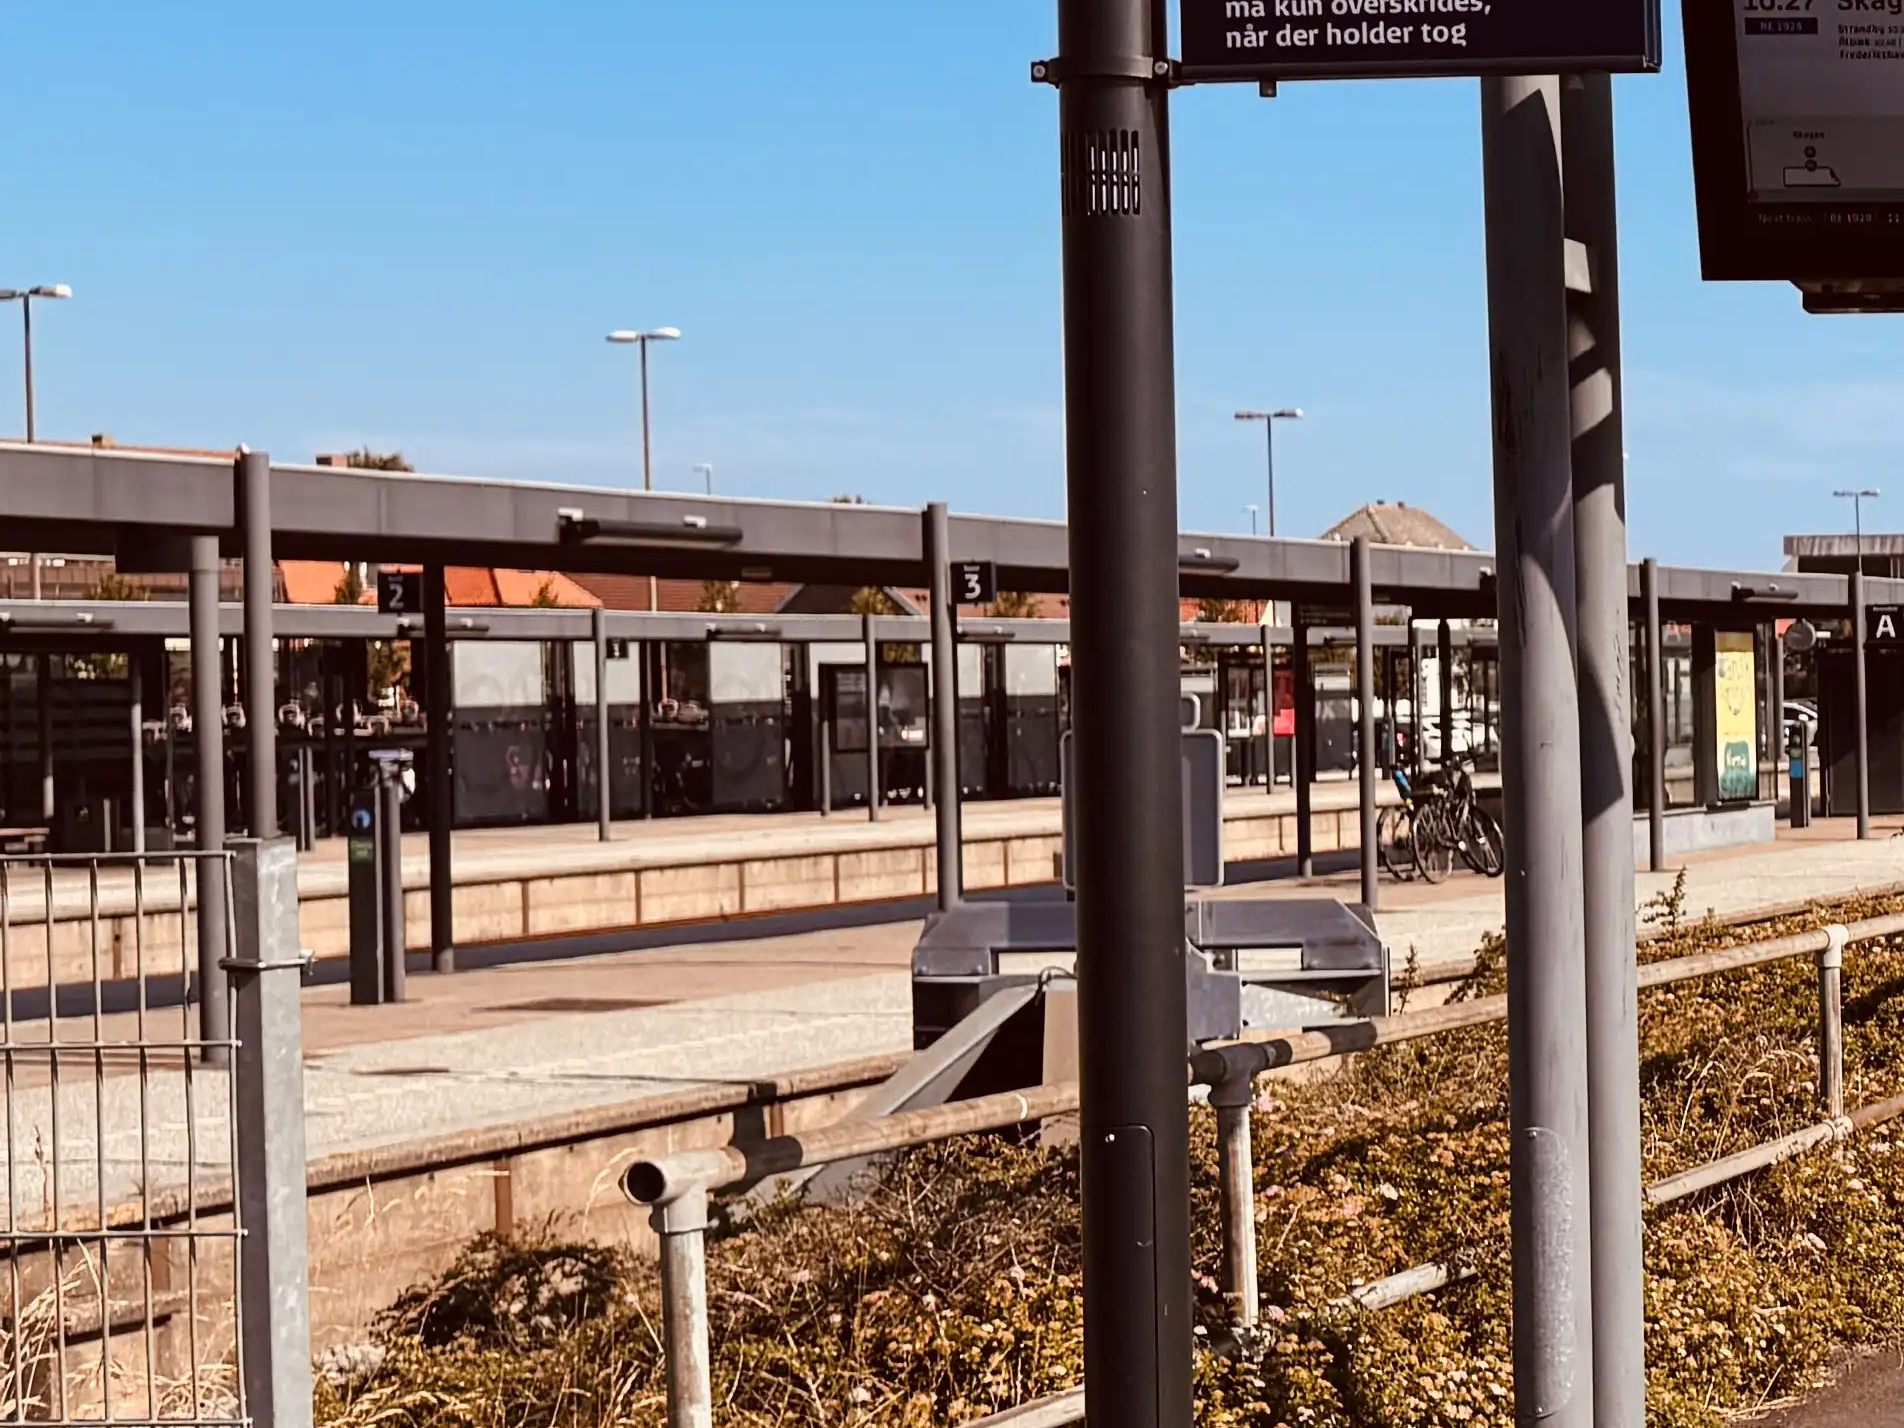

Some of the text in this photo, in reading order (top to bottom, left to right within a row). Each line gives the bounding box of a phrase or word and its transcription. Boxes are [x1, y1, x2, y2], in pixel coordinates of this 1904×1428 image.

[1226, 20, 1467, 49] når der holder tog
[388, 582, 405, 610] 2
[964, 573, 981, 600] 3
[1876, 614, 1896, 639] A
